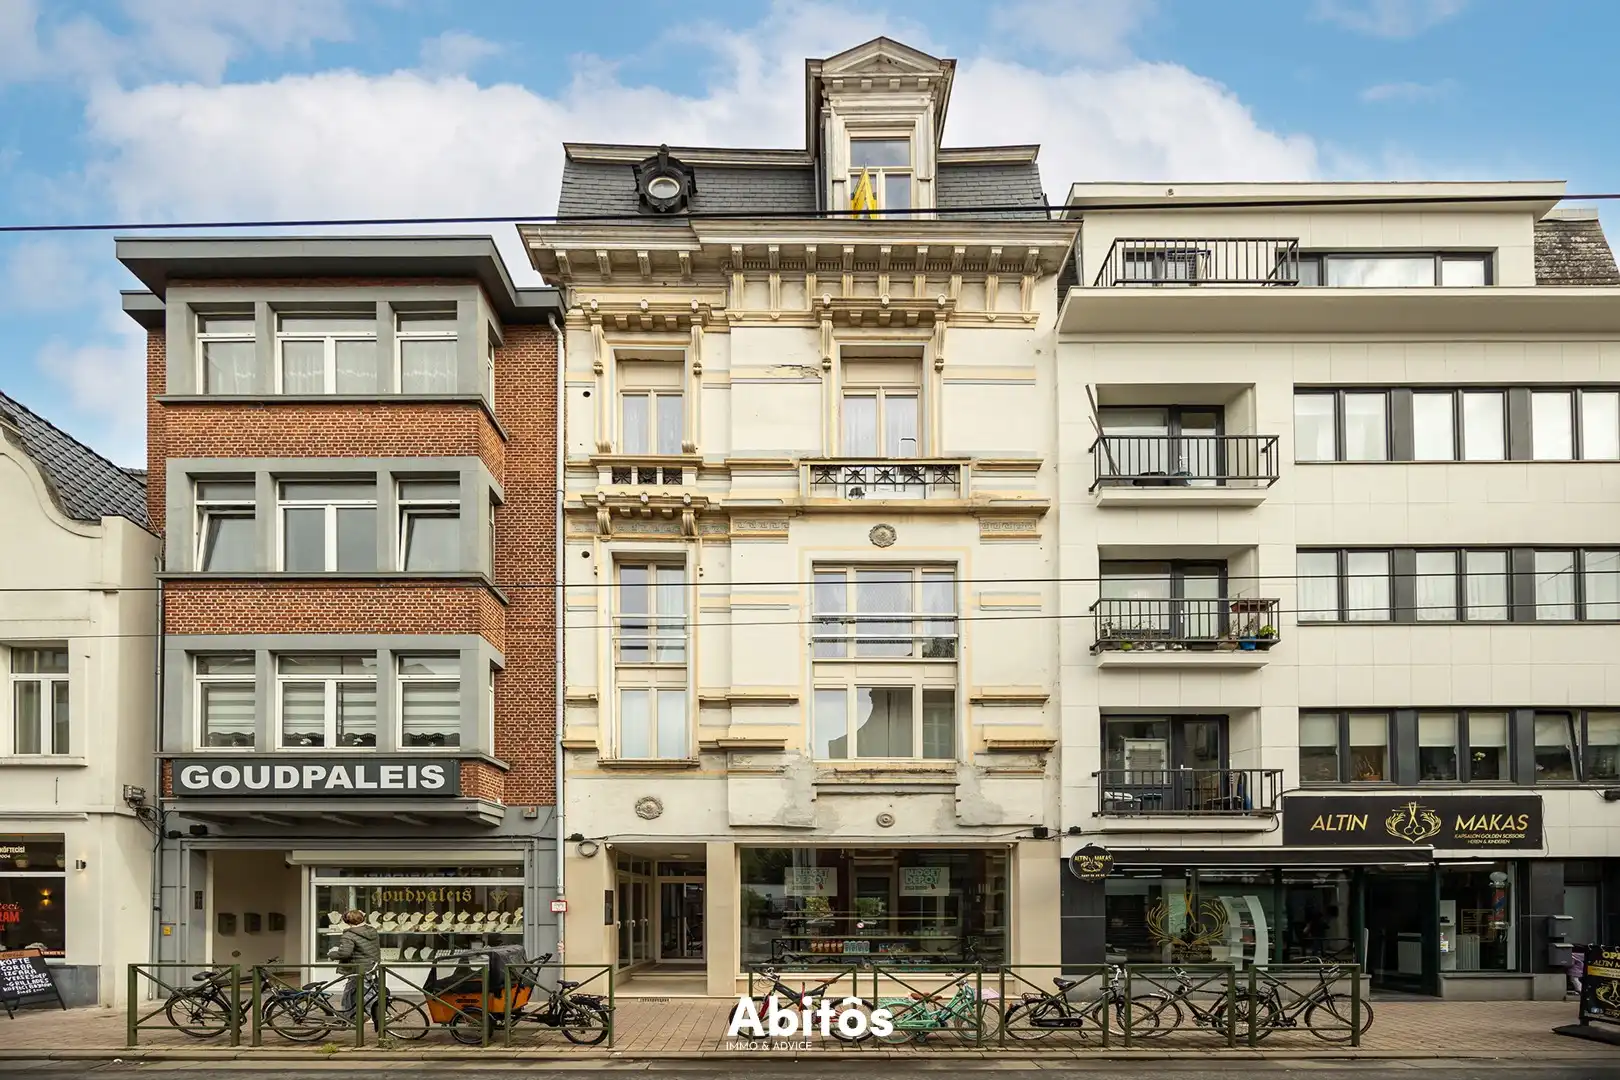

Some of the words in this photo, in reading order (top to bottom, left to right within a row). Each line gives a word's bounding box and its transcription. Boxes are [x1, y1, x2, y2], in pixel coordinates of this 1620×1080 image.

[180, 765, 446, 790] GOUDPALEIS
[1310, 814, 1369, 832] ALTIN
[1455, 814, 1529, 832] MAKAS
[905, 868, 941, 876] BUDGET
[371, 886, 473, 907] goudpaleis
